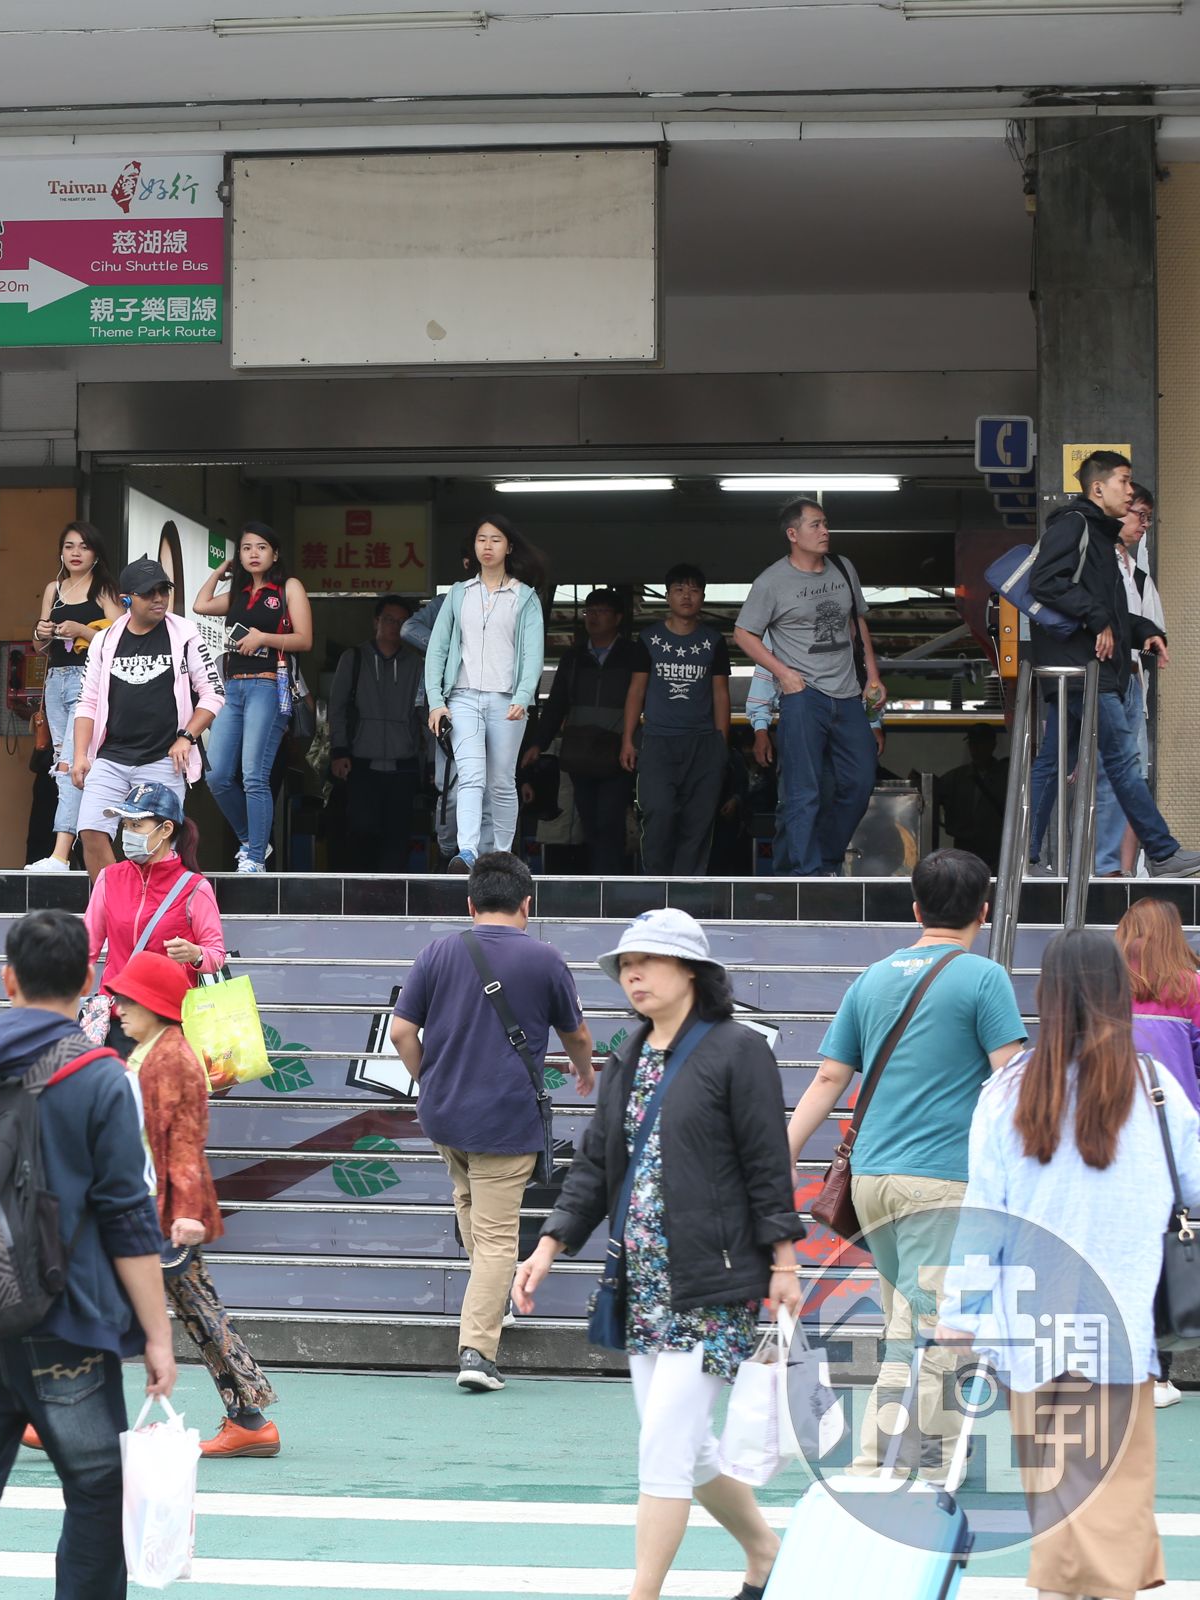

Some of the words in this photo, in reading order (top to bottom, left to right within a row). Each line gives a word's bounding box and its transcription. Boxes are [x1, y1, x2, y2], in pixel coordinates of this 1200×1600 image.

[47, 179, 108, 195] Taiwan
[111, 229, 188, 255] 慈湖線
[90, 260, 122, 273] Cihu
[125, 260, 178, 272] Shuttle
[182, 260, 209, 272] Bus
[89, 296, 217, 323] 親子樂園線
[89, 326, 133, 338] Theme
[138, 326, 172, 338] Park
[175, 325, 217, 338] Route
[300, 541, 425, 570] 禁止進入
[321, 578, 345, 590] No
[350, 578, 394, 592] Entry
